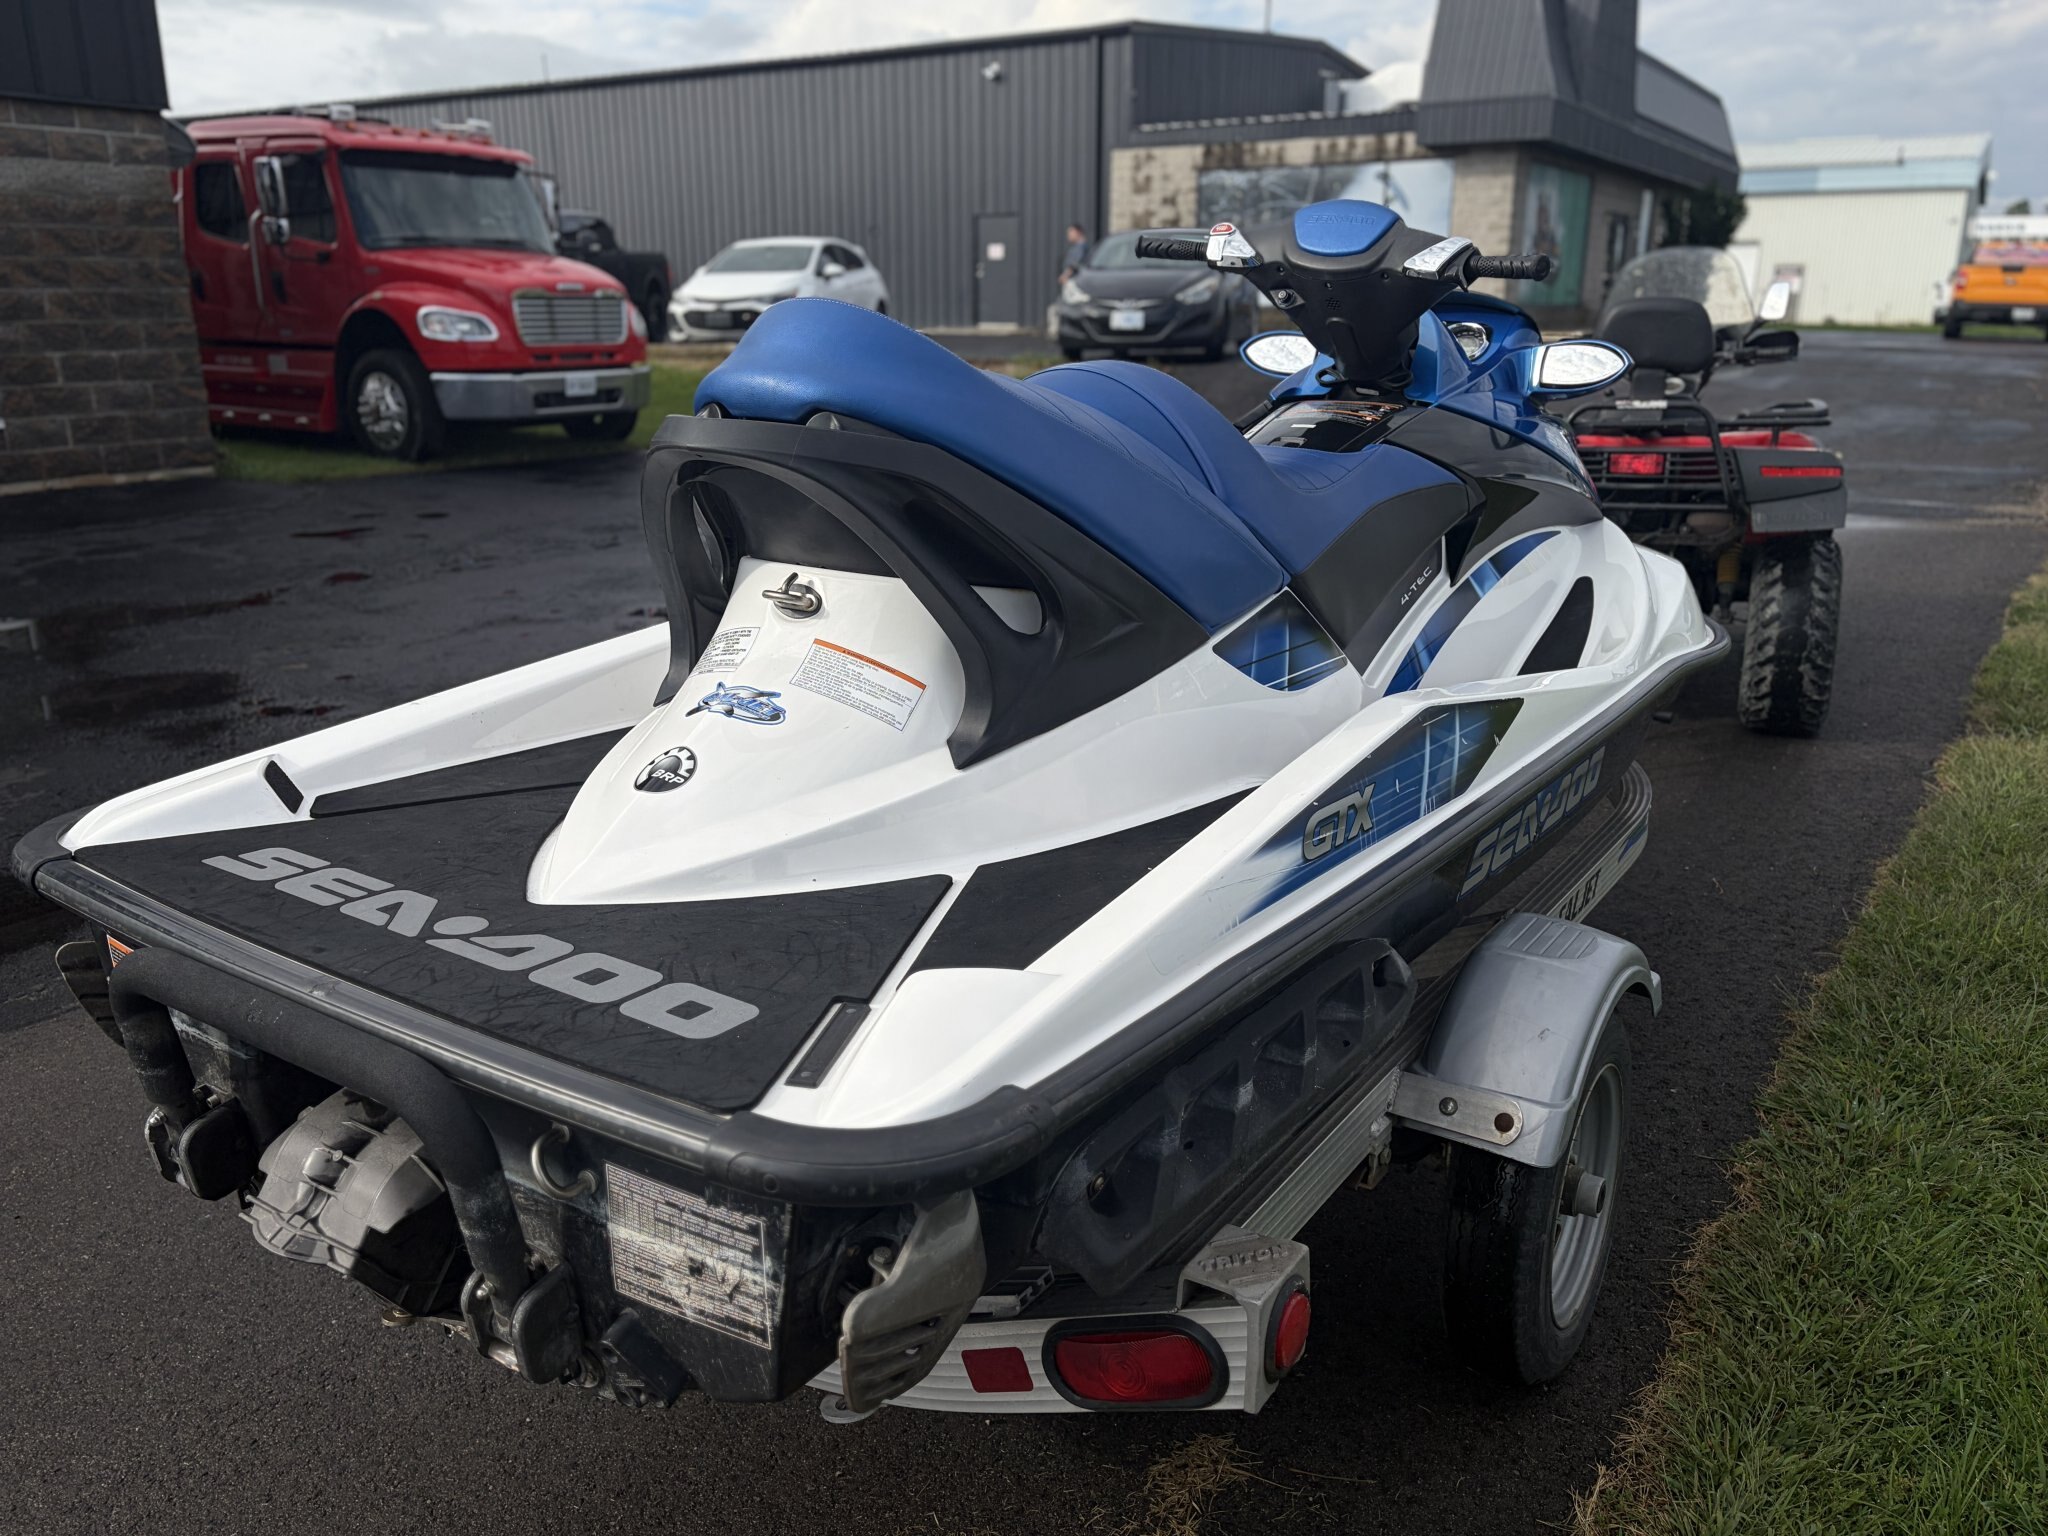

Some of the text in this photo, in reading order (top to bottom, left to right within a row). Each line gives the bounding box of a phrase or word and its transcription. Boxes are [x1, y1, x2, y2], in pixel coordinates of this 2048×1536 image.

[1401, 566, 1432, 605] 4-TEC
[651, 769, 684, 783] BRP
[1302, 782, 1376, 861] GTX
[1199, 1244, 1288, 1272] TRITON
